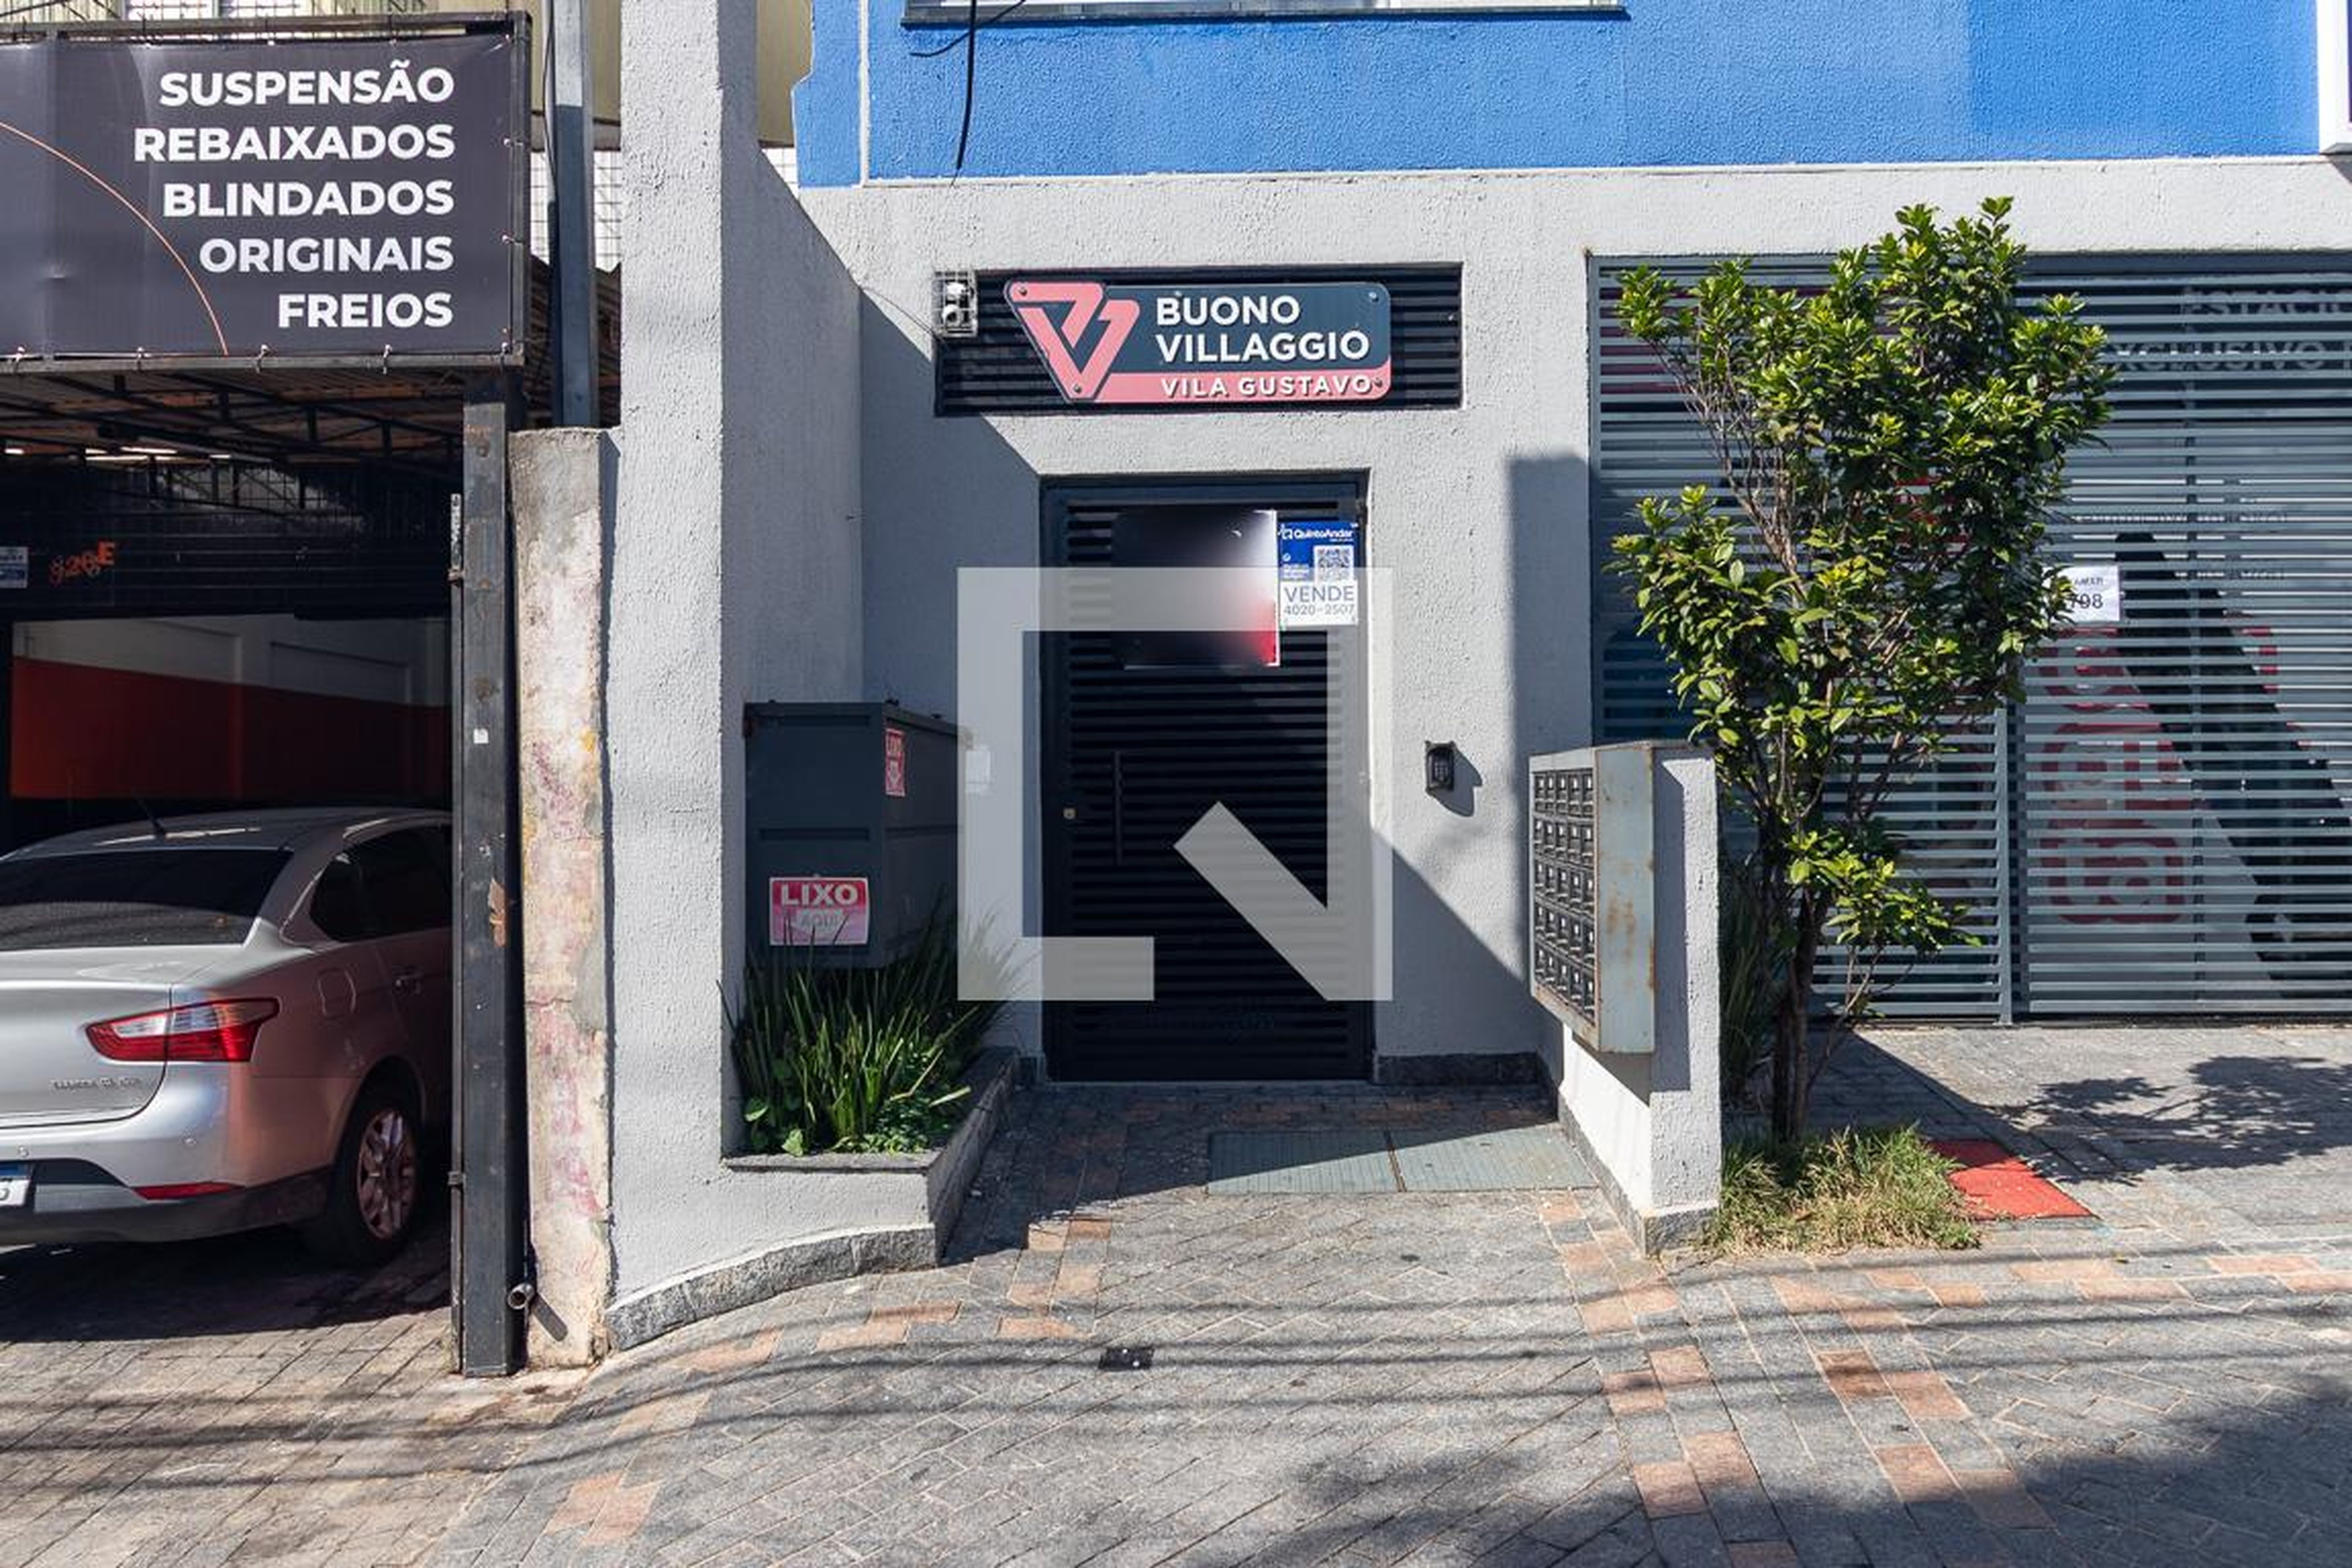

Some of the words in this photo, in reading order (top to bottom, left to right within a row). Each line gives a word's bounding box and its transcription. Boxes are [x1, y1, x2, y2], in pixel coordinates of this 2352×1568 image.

[160, 59, 454, 106] SUSPENSÃO
[134, 124, 454, 162] REBAIXADOS
[164, 180, 454, 217] BLINDADOS
[200, 236, 453, 273] ORIGINAIS
[279, 293, 453, 328] FREIOS
[1157, 296, 1300, 326] BUONO
[1156, 331, 1369, 363] VILLAGGIO
[1161, 377, 1228, 398] VILA
[1240, 375, 1371, 397] GUSTAVO
[1284, 586, 1354, 602] VENDE
[1284, 604, 1354, 616] 4020-2507
[782, 884, 858, 905] LIXO
